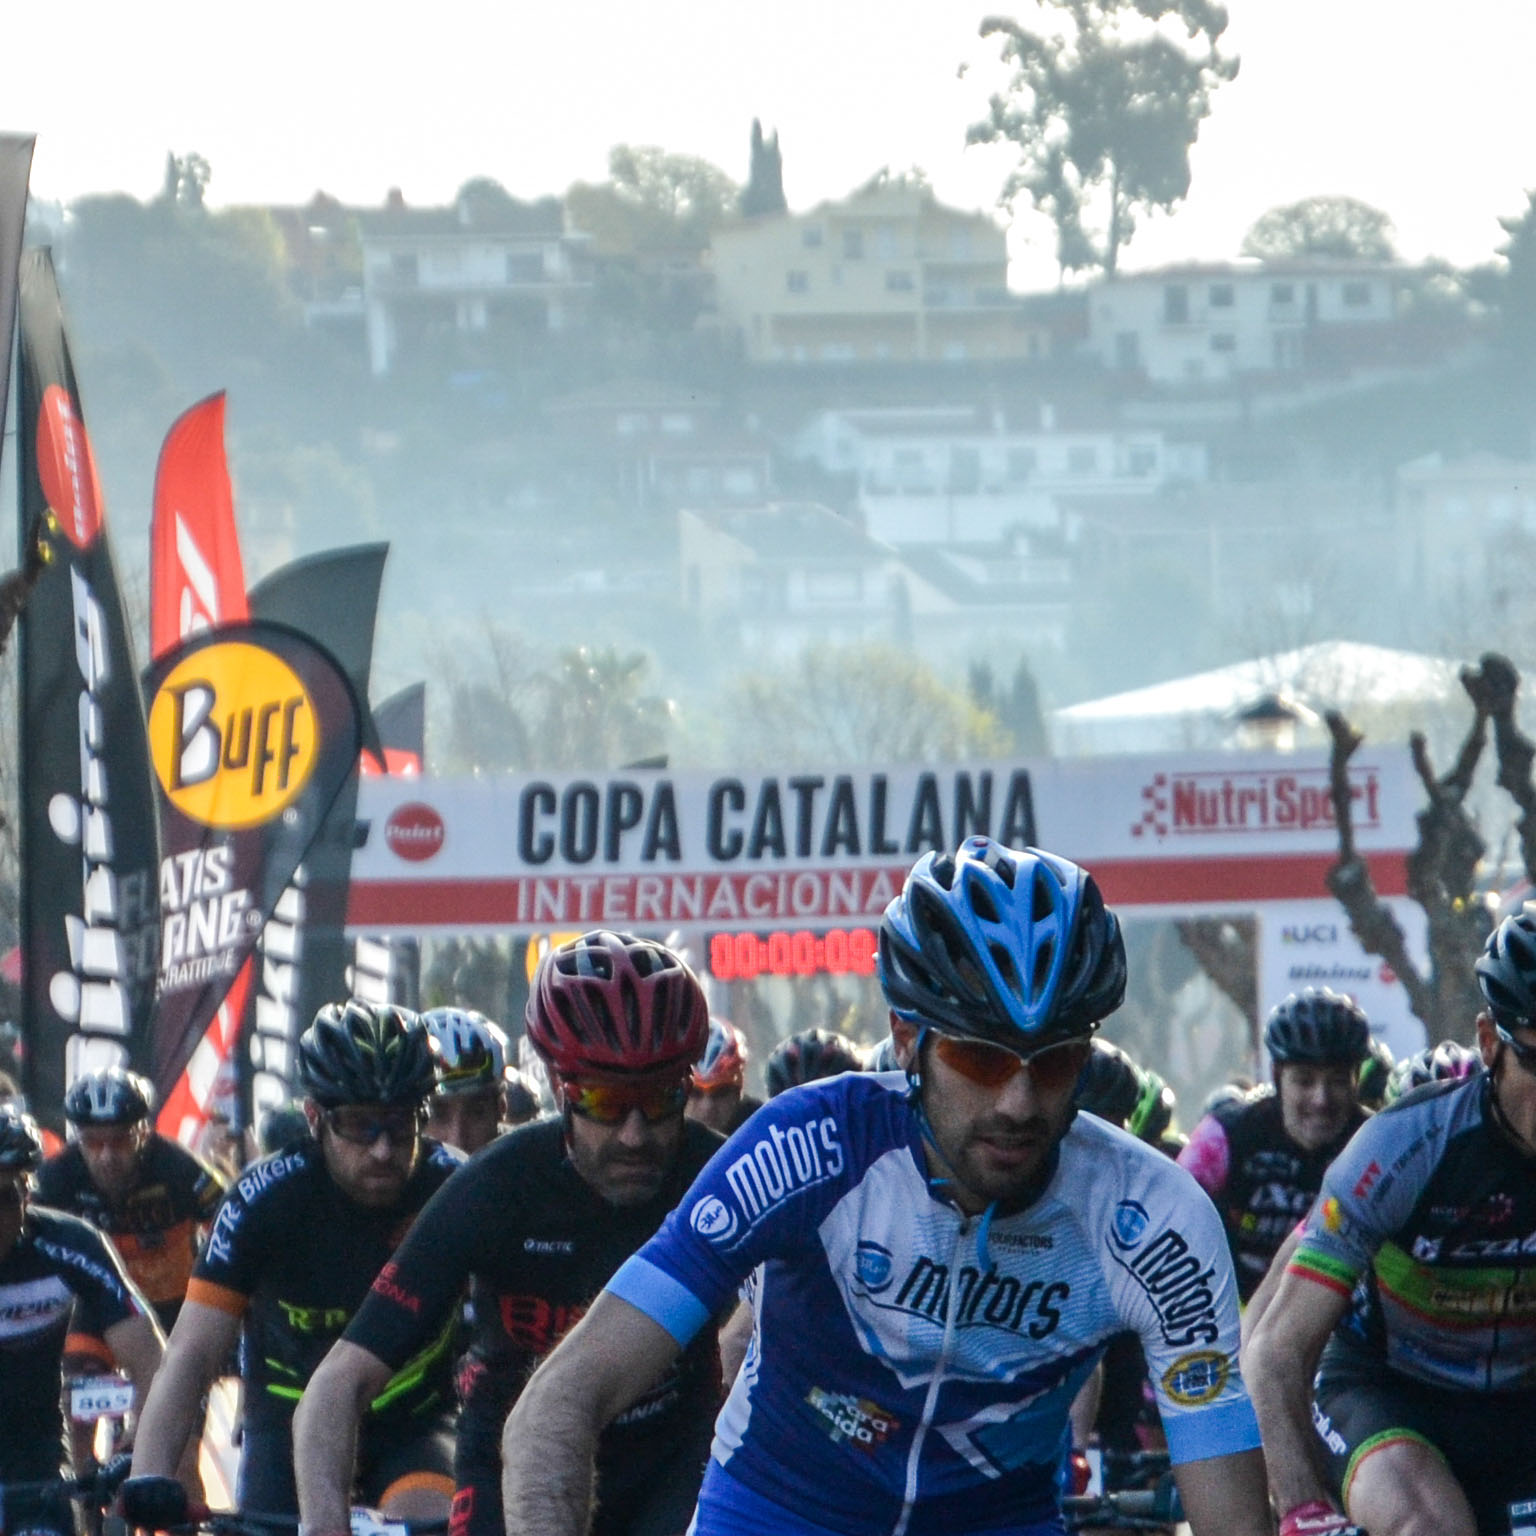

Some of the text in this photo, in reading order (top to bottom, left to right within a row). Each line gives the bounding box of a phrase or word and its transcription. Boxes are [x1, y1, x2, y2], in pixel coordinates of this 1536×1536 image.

[517, 768, 1039, 866] COPA CATALANA
[517, 869, 920, 923] INTERNACIONA
[1289, 926, 1338, 944] UCI
[238, 1151, 306, 1206] Bikers
[726, 1117, 845, 1222] motors
[895, 1255, 1070, 1340] motors
[1131, 1228, 1220, 1347] motors
